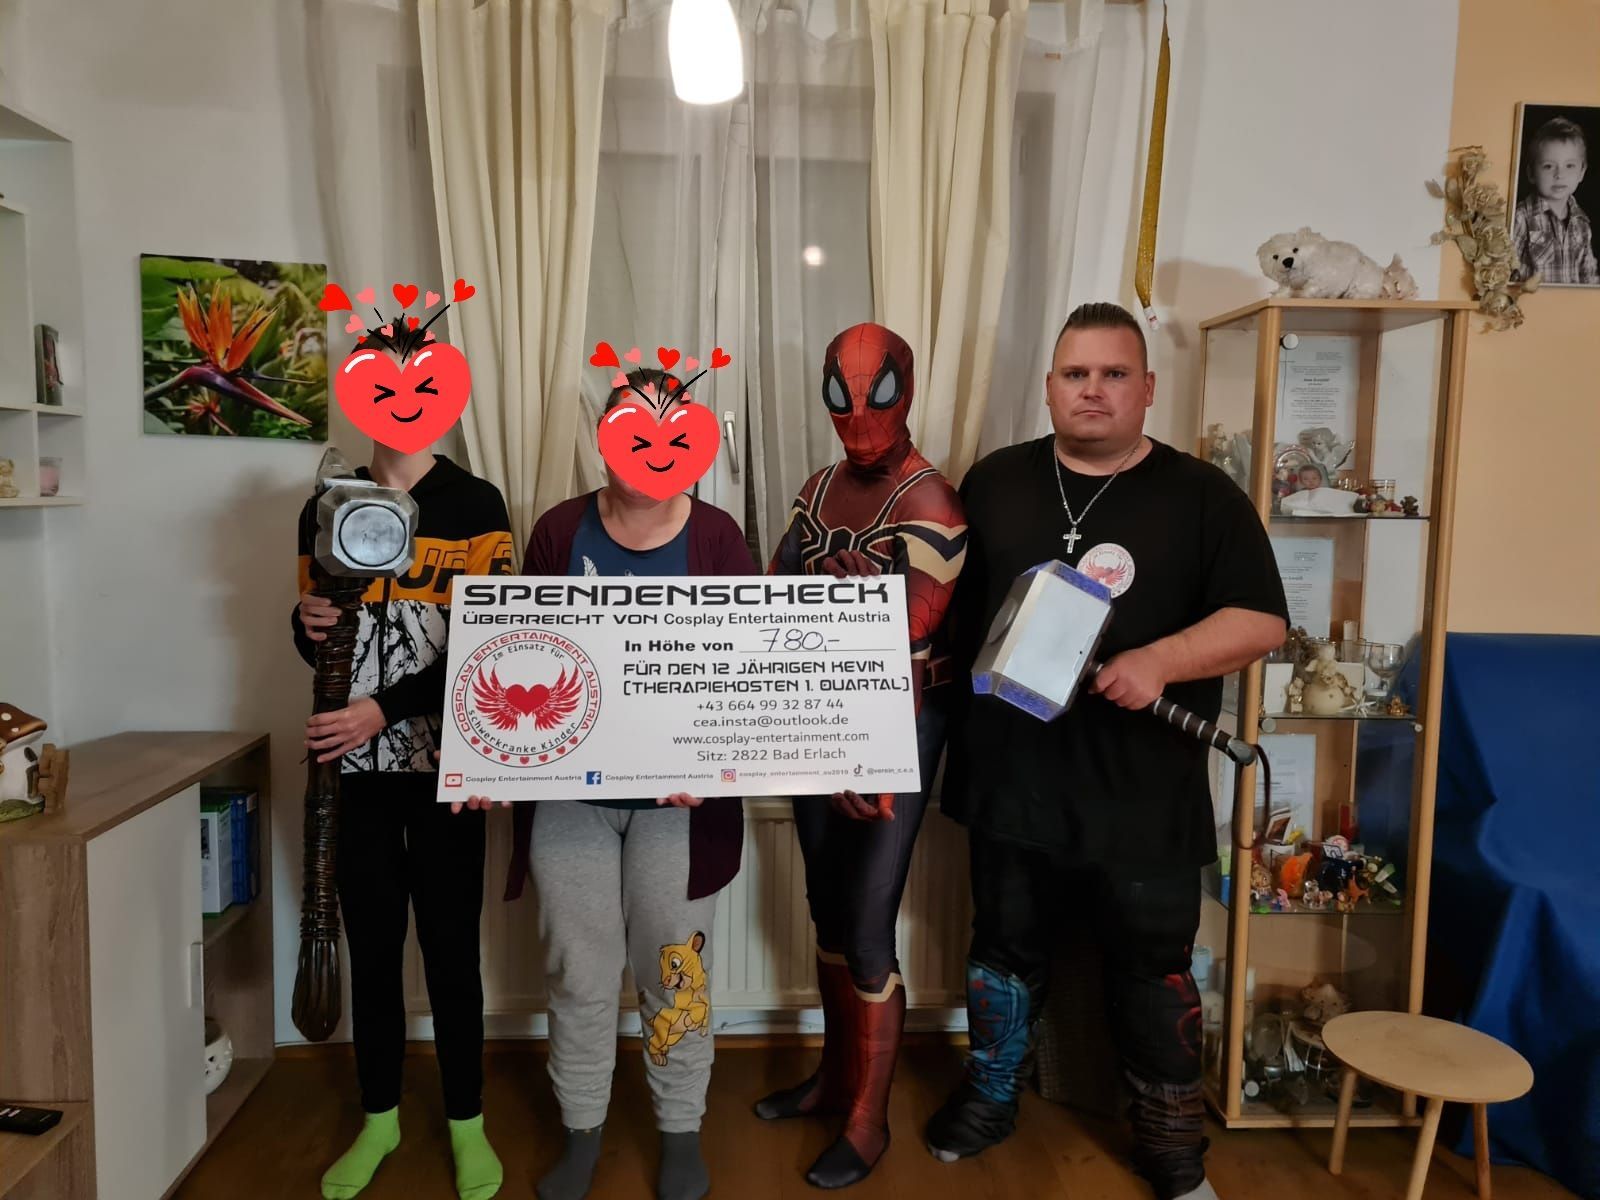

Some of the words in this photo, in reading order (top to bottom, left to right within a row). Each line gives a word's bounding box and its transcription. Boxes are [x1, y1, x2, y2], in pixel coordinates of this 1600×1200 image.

[463, 583, 889, 606] SPENDENSCHECK
[462, 611, 605, 625] ÜBERREICHT
[613, 614, 658, 625] VON
[664, 612, 724, 627] Cosplay
[728, 611, 834, 625] Entertainment
[837, 611, 890, 623] Austria
[507, 643, 545, 654] Einsatz
[550, 647, 565, 660] für
[625, 639, 642, 652] In
[648, 639, 697, 652] Höhe
[702, 641, 734, 652] von
[623, 660, 662, 676] FÜR
[668, 663, 706, 676] DEN
[712, 662, 730, 675] 12
[736, 659, 826, 675] JÄHRIGEN
[831, 660, 884, 673] KEVIN
[455, 663, 474, 733] COSPLAY
[473, 631, 588, 665] ENTERTAINMENT
[580, 670, 599, 731] AUSTRIA
[805, 679, 814, 692] 1.
[697, 700, 724, 711] +43
[728, 700, 756, 711] 664
[760, 699, 777, 711] 99
[783, 699, 799, 710] 32
[804, 698, 821, 710] 87
[826, 698, 844, 709] 44
[693, 713, 849, 728] cea.insta@outlook.de
[468, 709, 536, 754] schwerkranke
[541, 722, 577, 750] Kinder
[672, 732, 870, 746] www.cosplay-entertainment.com
[697, 749, 727, 761] Sitz:
[731, 749, 768, 761] 2822
[773, 748, 799, 760] Bad
[804, 747, 846, 760] Erlach
[465, 775, 497, 783] Cosplay
[498, 774, 553, 782] Entertainment
